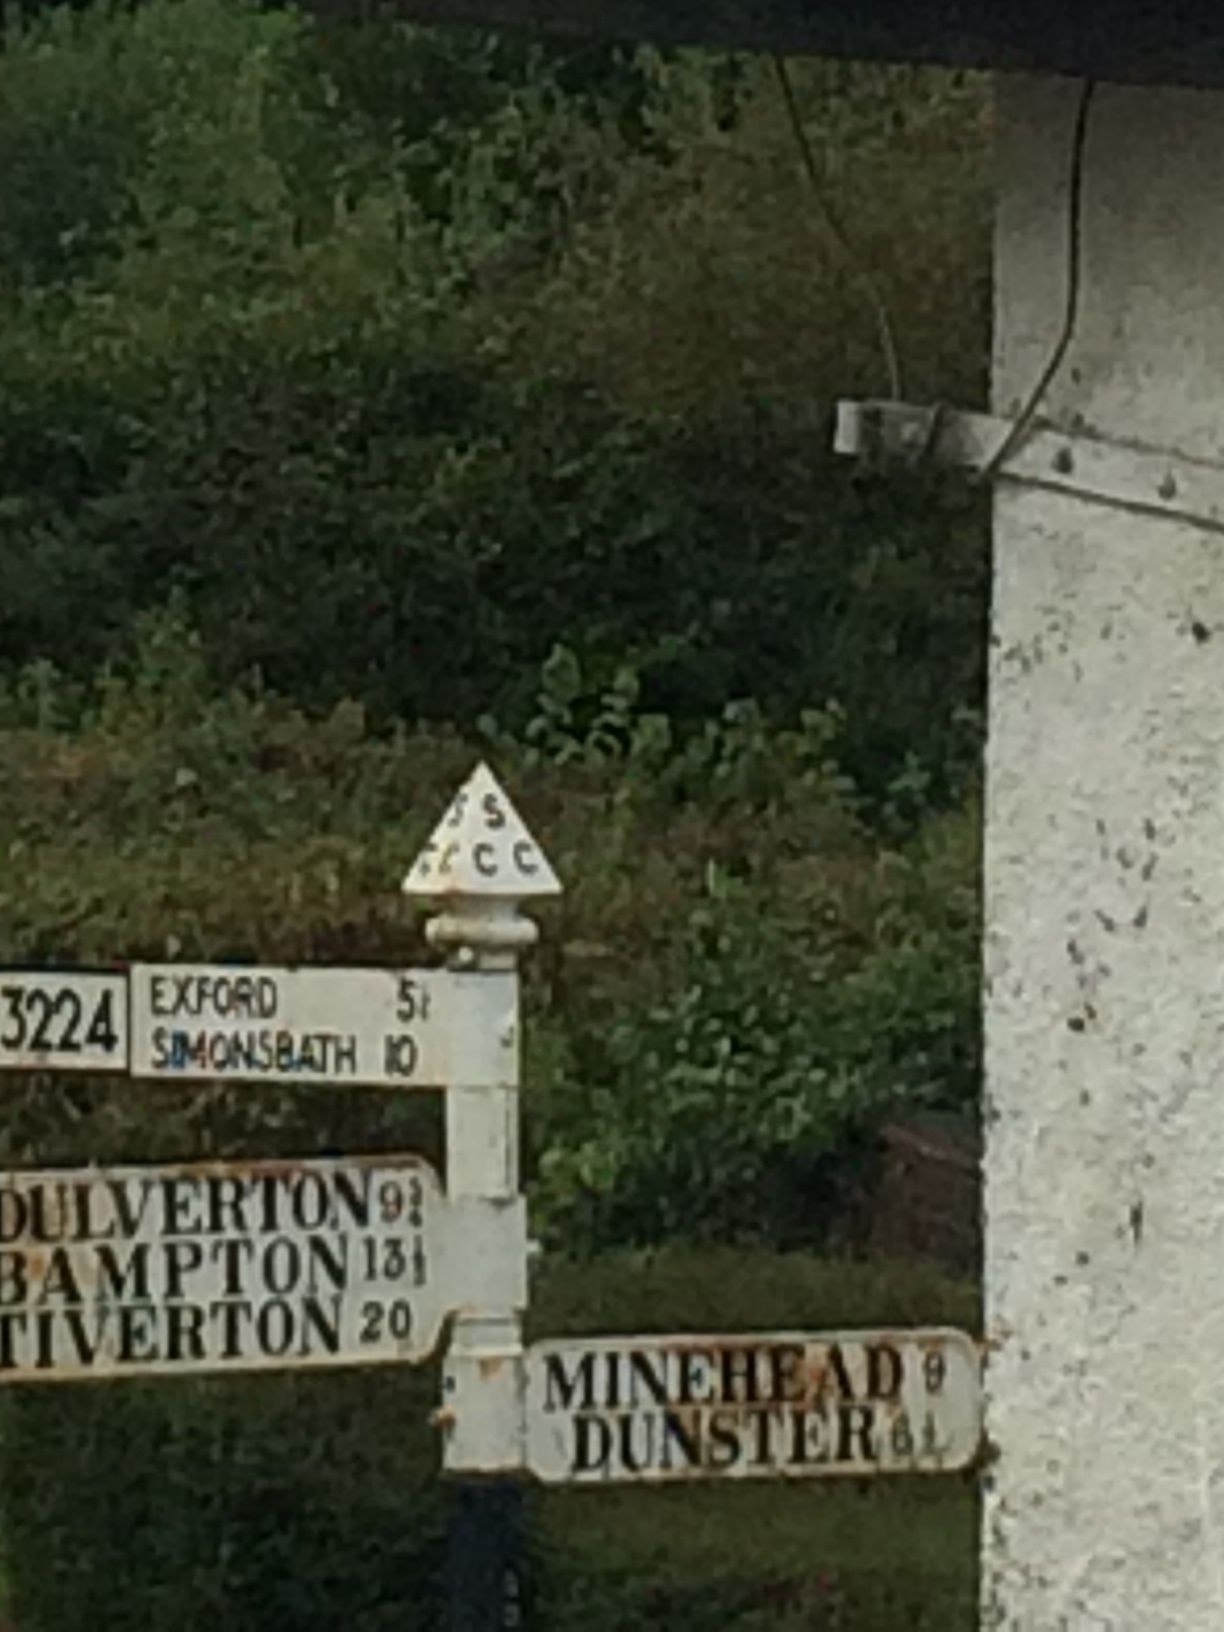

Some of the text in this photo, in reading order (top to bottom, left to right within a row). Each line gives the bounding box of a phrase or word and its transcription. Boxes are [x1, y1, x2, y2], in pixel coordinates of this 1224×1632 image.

[483, 793, 506, 829] S
[150, 976, 277, 1018] EXFORD
[151, 1028, 418, 1076] SIMONSBATH 10
[359, 1299, 412, 1344] 20
[543, 1341, 904, 1412] MINEHEAD
[573, 1403, 877, 1473] DUNSTER
